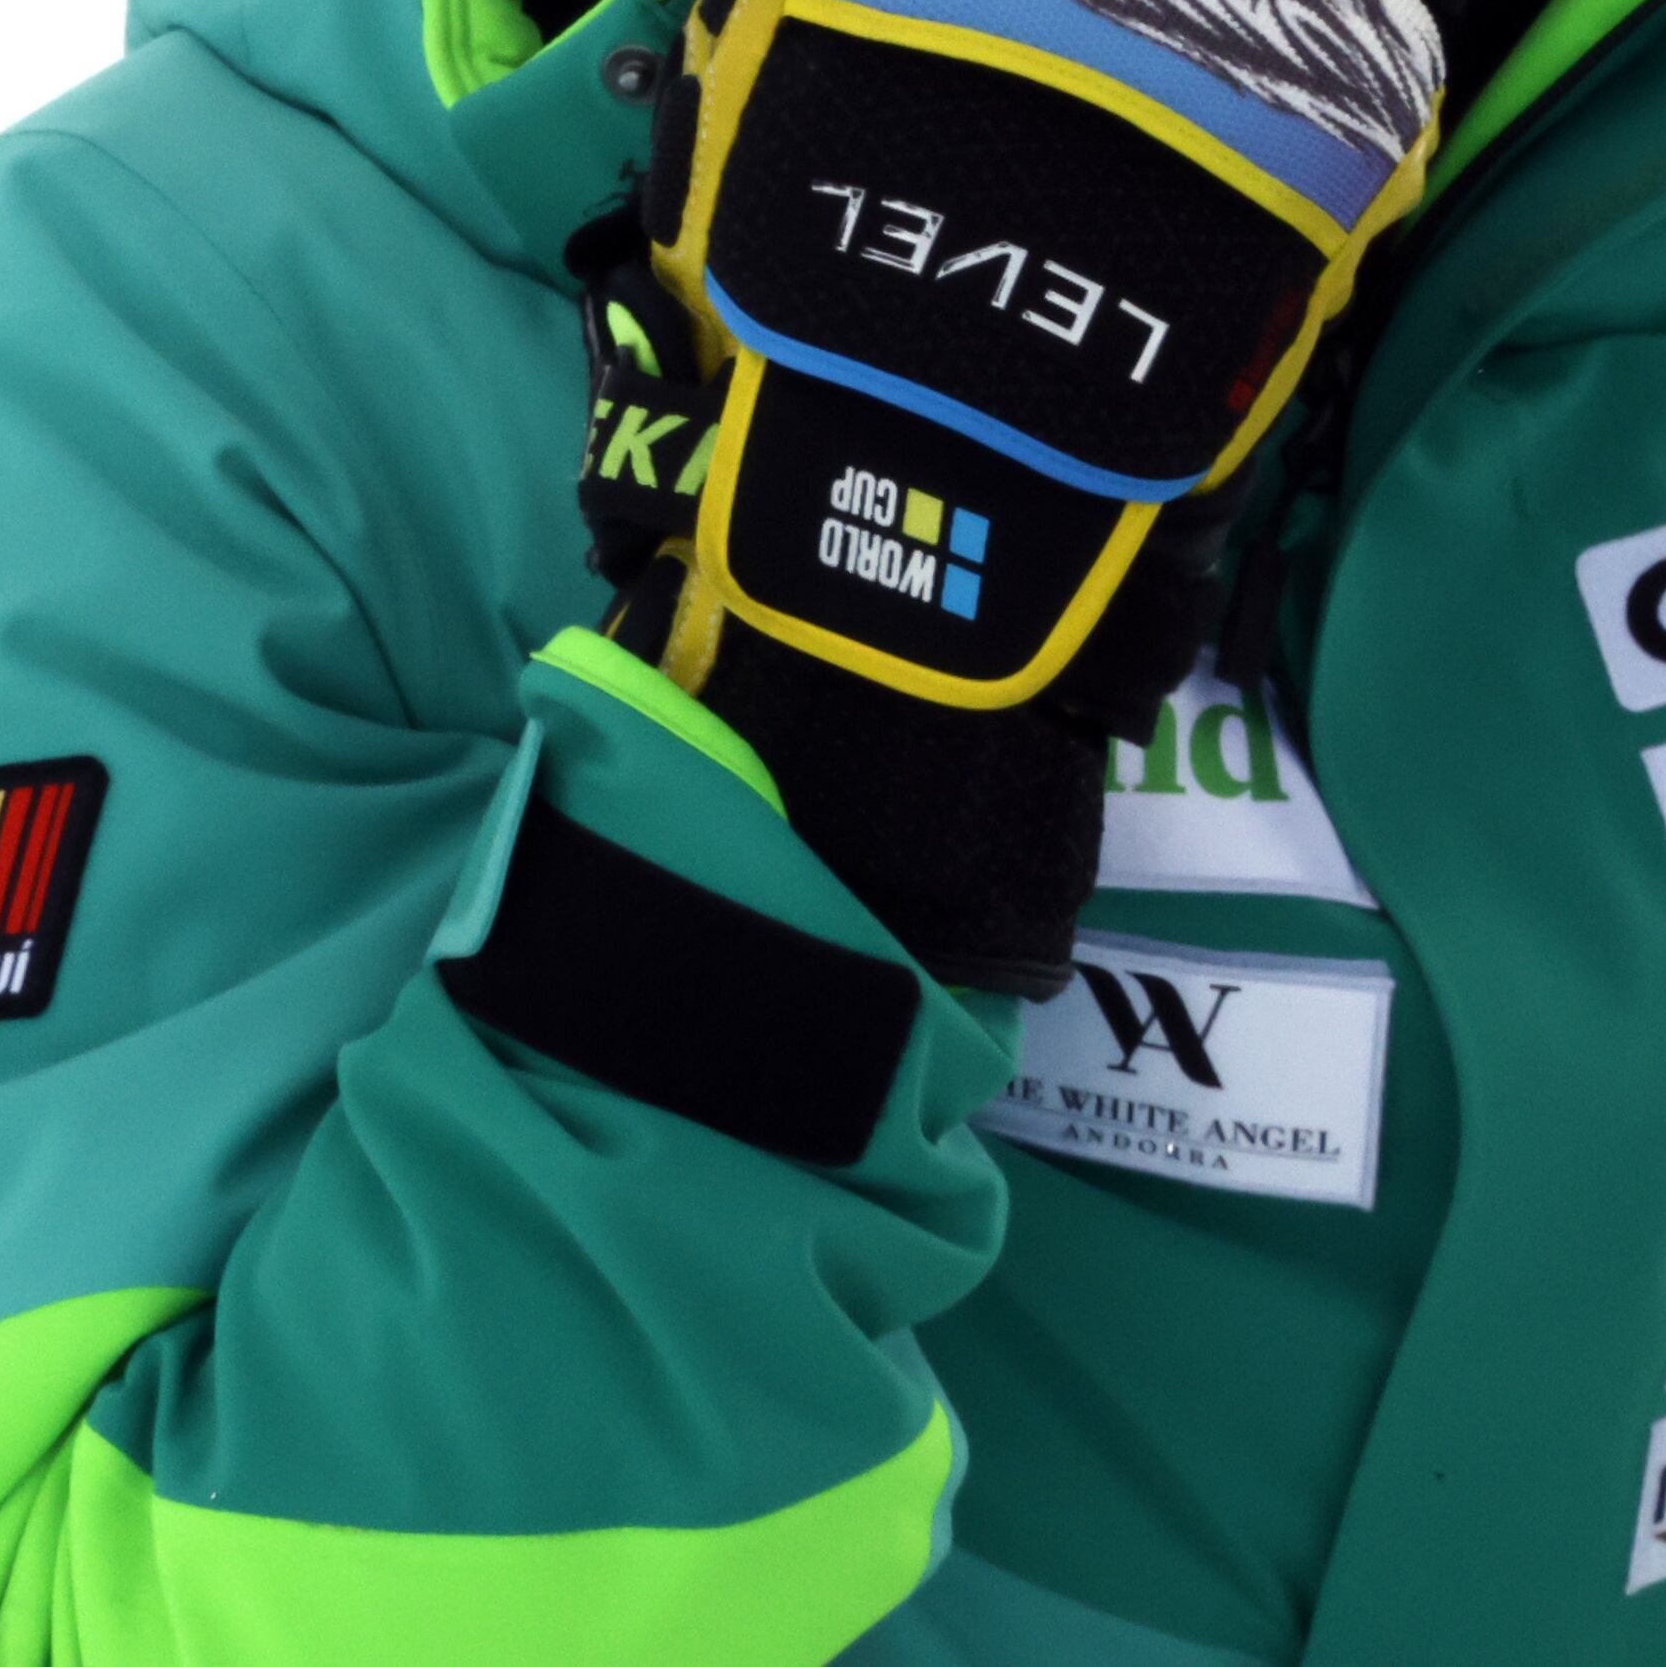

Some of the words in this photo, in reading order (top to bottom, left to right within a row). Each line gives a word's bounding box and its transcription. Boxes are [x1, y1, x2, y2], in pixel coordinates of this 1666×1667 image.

[811, 177, 1170, 385] LEVEL
[830, 465, 900, 525] CUP
[819, 517, 937, 604] WORLD
[1058, 1085, 1190, 1136] WHITE
[1205, 1118, 1341, 1157] ANGEL
[1063, 1122, 1231, 1171] ANDORRA
